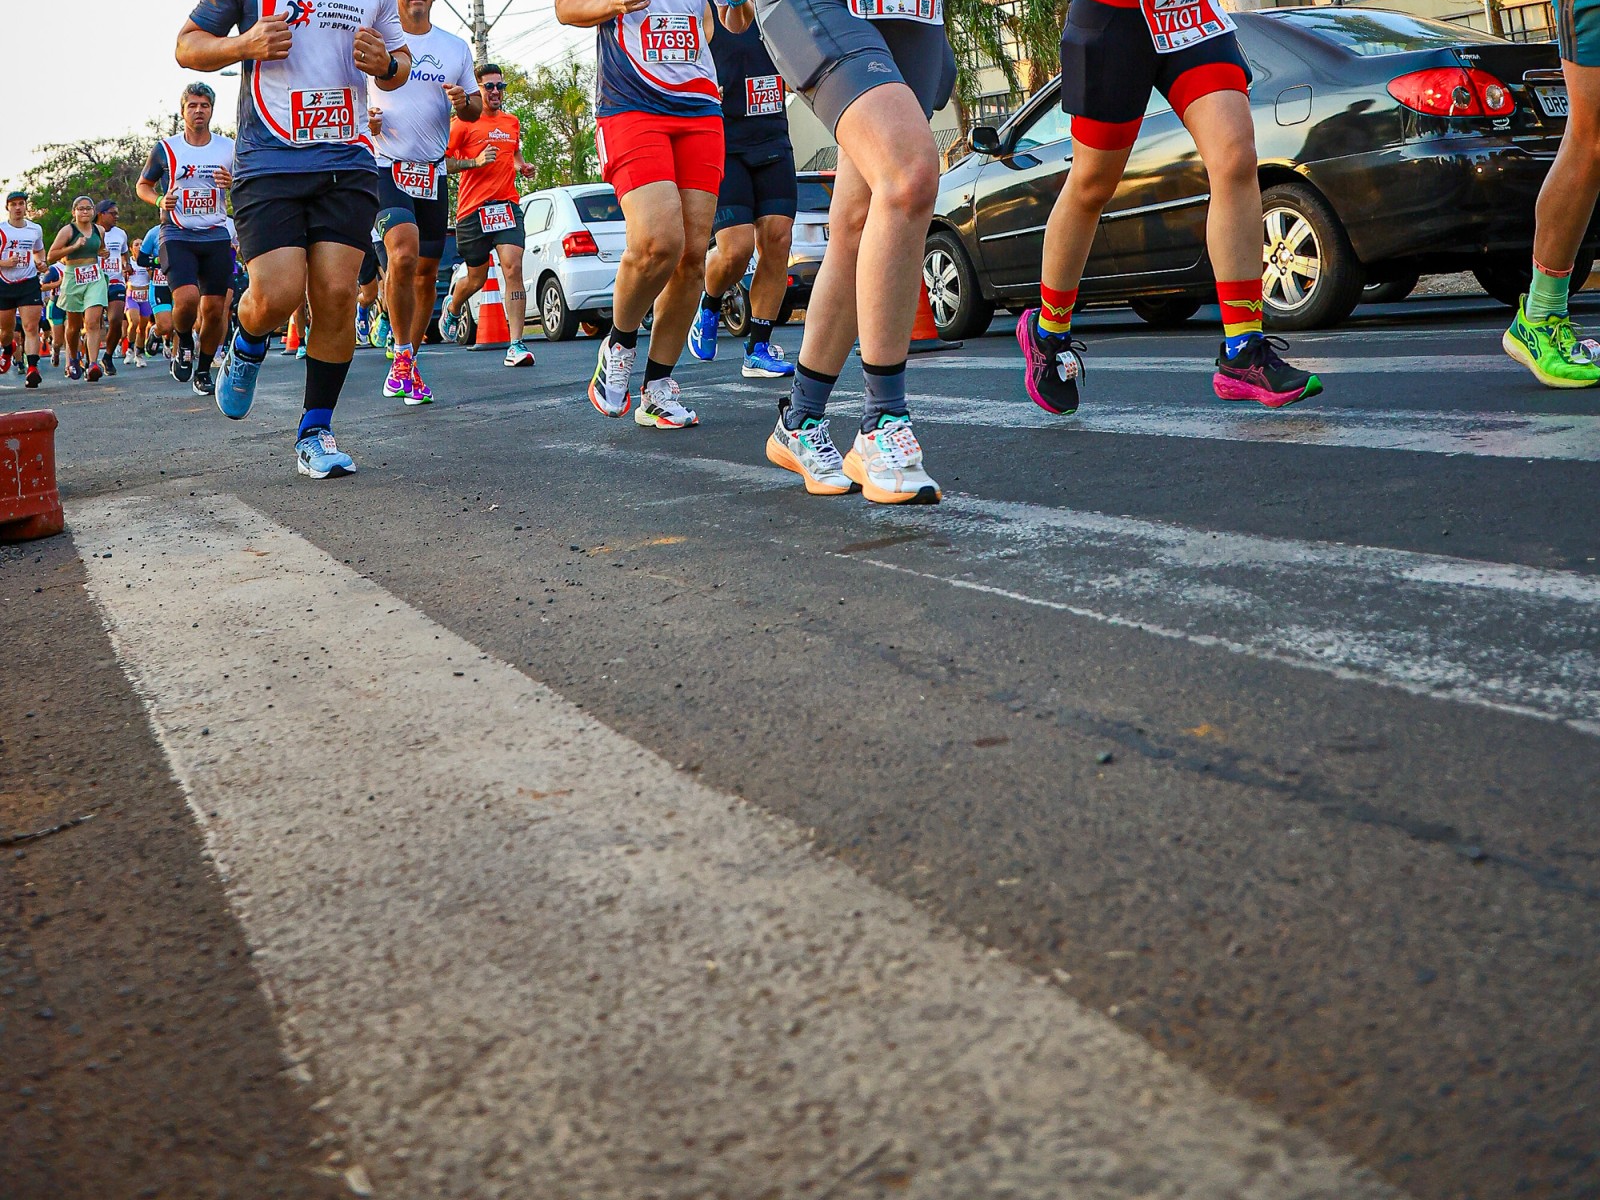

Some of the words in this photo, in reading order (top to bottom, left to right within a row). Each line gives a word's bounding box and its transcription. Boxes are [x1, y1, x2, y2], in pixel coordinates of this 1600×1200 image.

[328, 2, 360, 13] CORRIDA
[317, 11, 362, 24] CAMINHADA
[1153, 6, 1202, 32] 17107
[646, 32, 695, 49] 17693
[410, 70, 446, 83] Move
[752, 89, 780, 104] 17289
[298, 108, 350, 127] 17240
[397, 173, 430, 188] 17375
[186, 199, 214, 207] 17030
[485, 214, 510, 224] 17376
